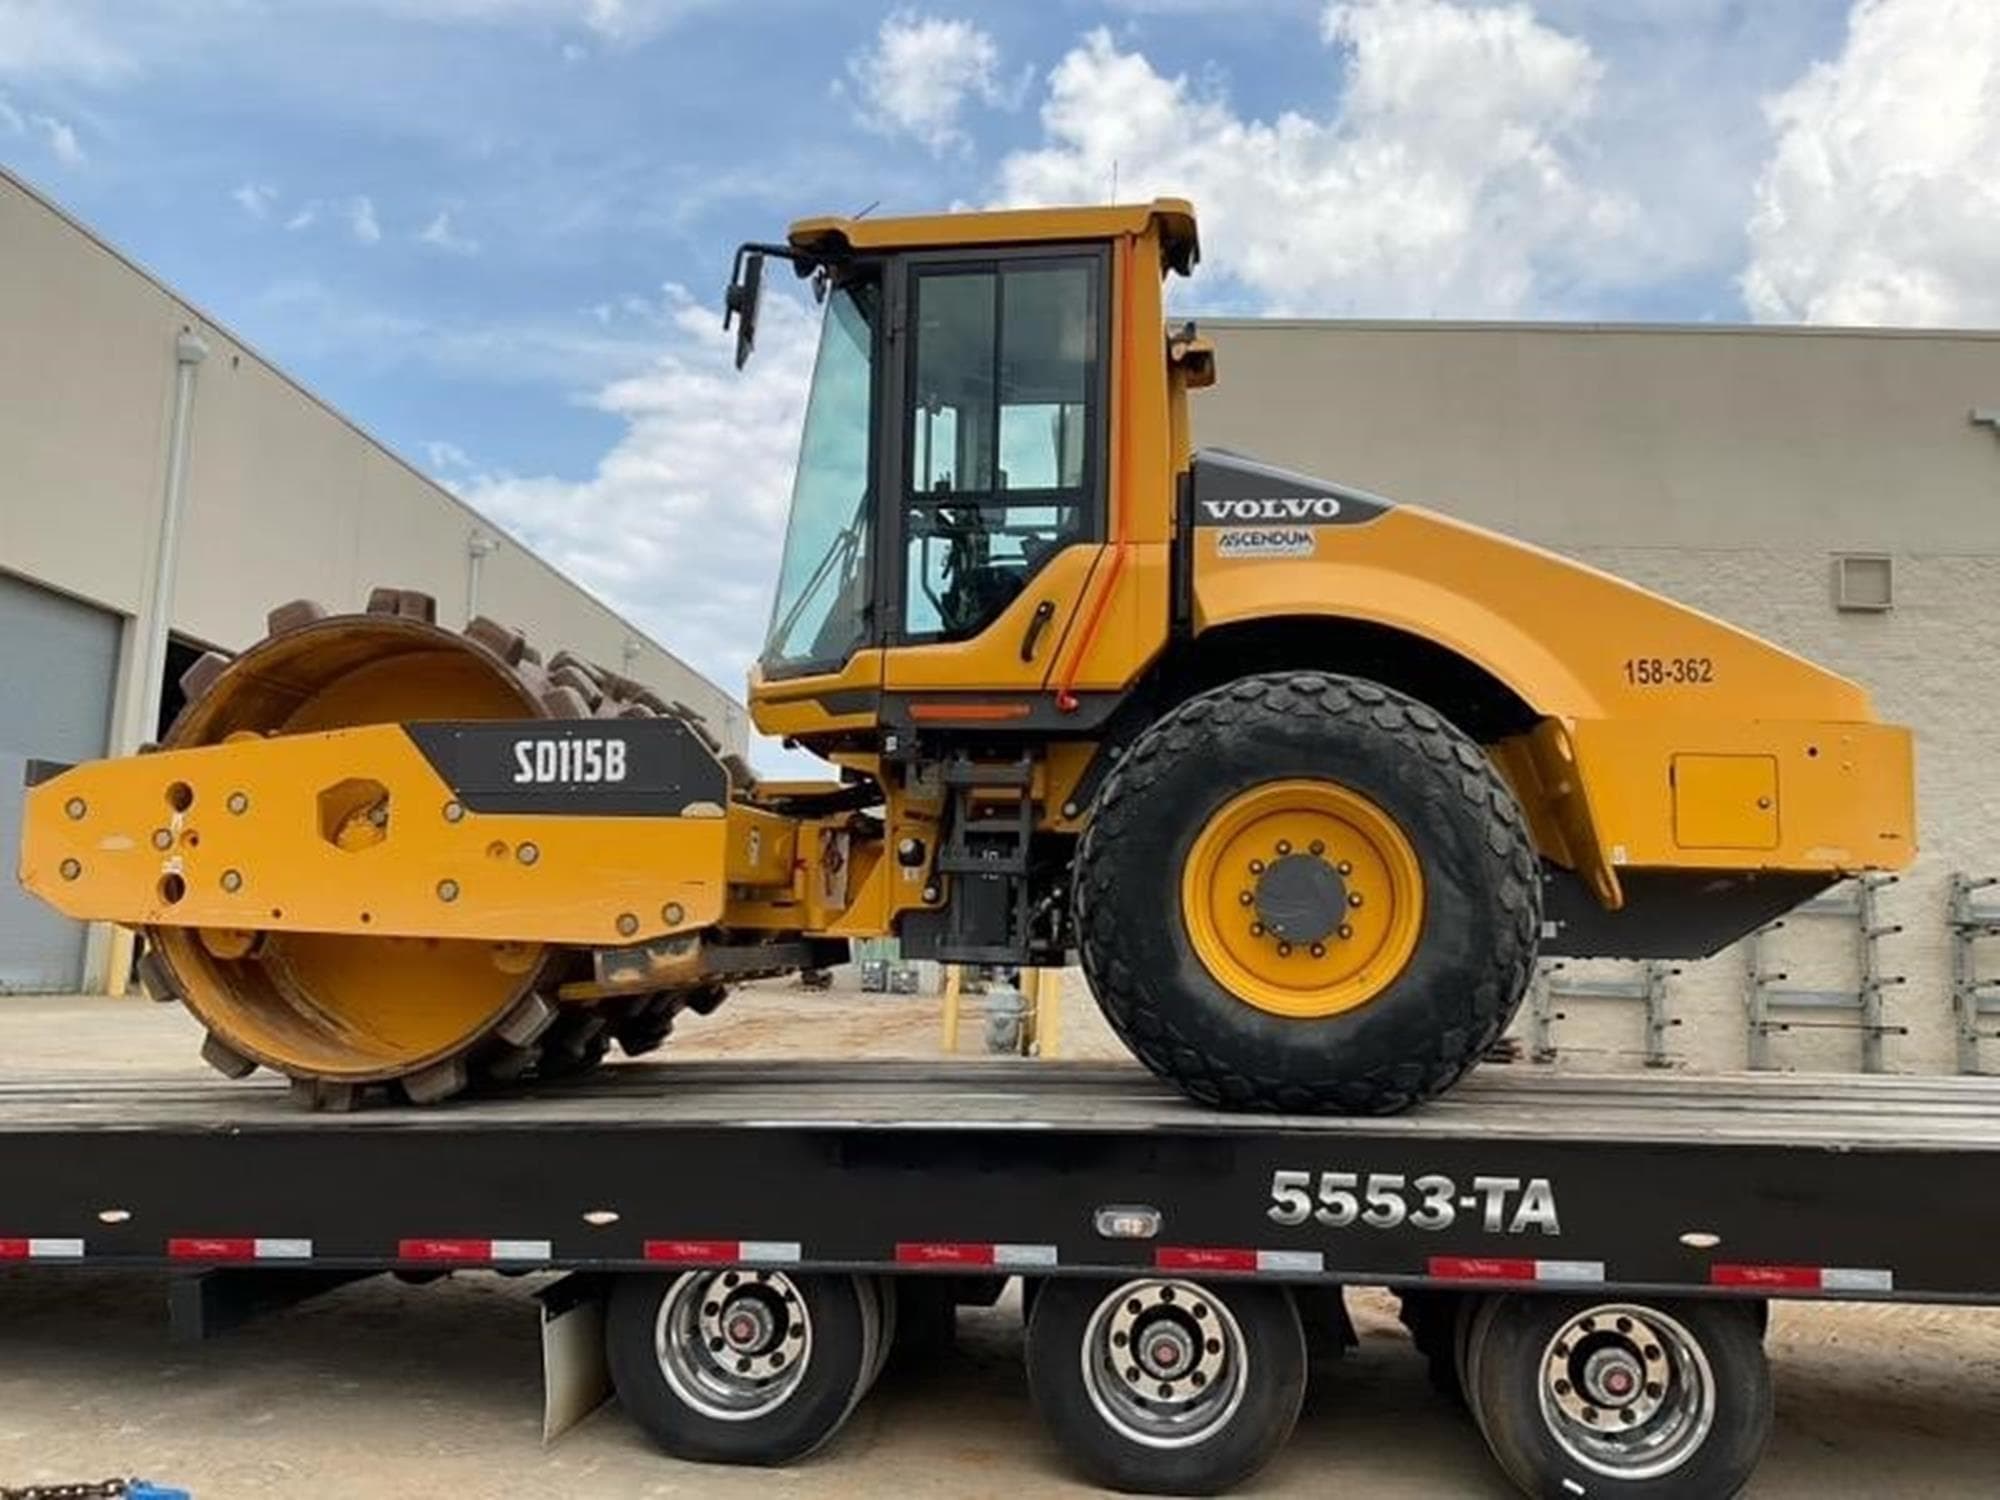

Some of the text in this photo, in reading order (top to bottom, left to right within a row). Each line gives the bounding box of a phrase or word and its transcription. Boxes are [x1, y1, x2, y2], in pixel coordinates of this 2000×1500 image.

[1202, 498, 1341, 519] VOLVO
[1219, 531, 1313, 547] ASCENDUM
[1624, 658, 1713, 685] 158-362
[513, 739, 627, 783] SD115B
[1267, 1170, 1561, 1235] 5553-TA
